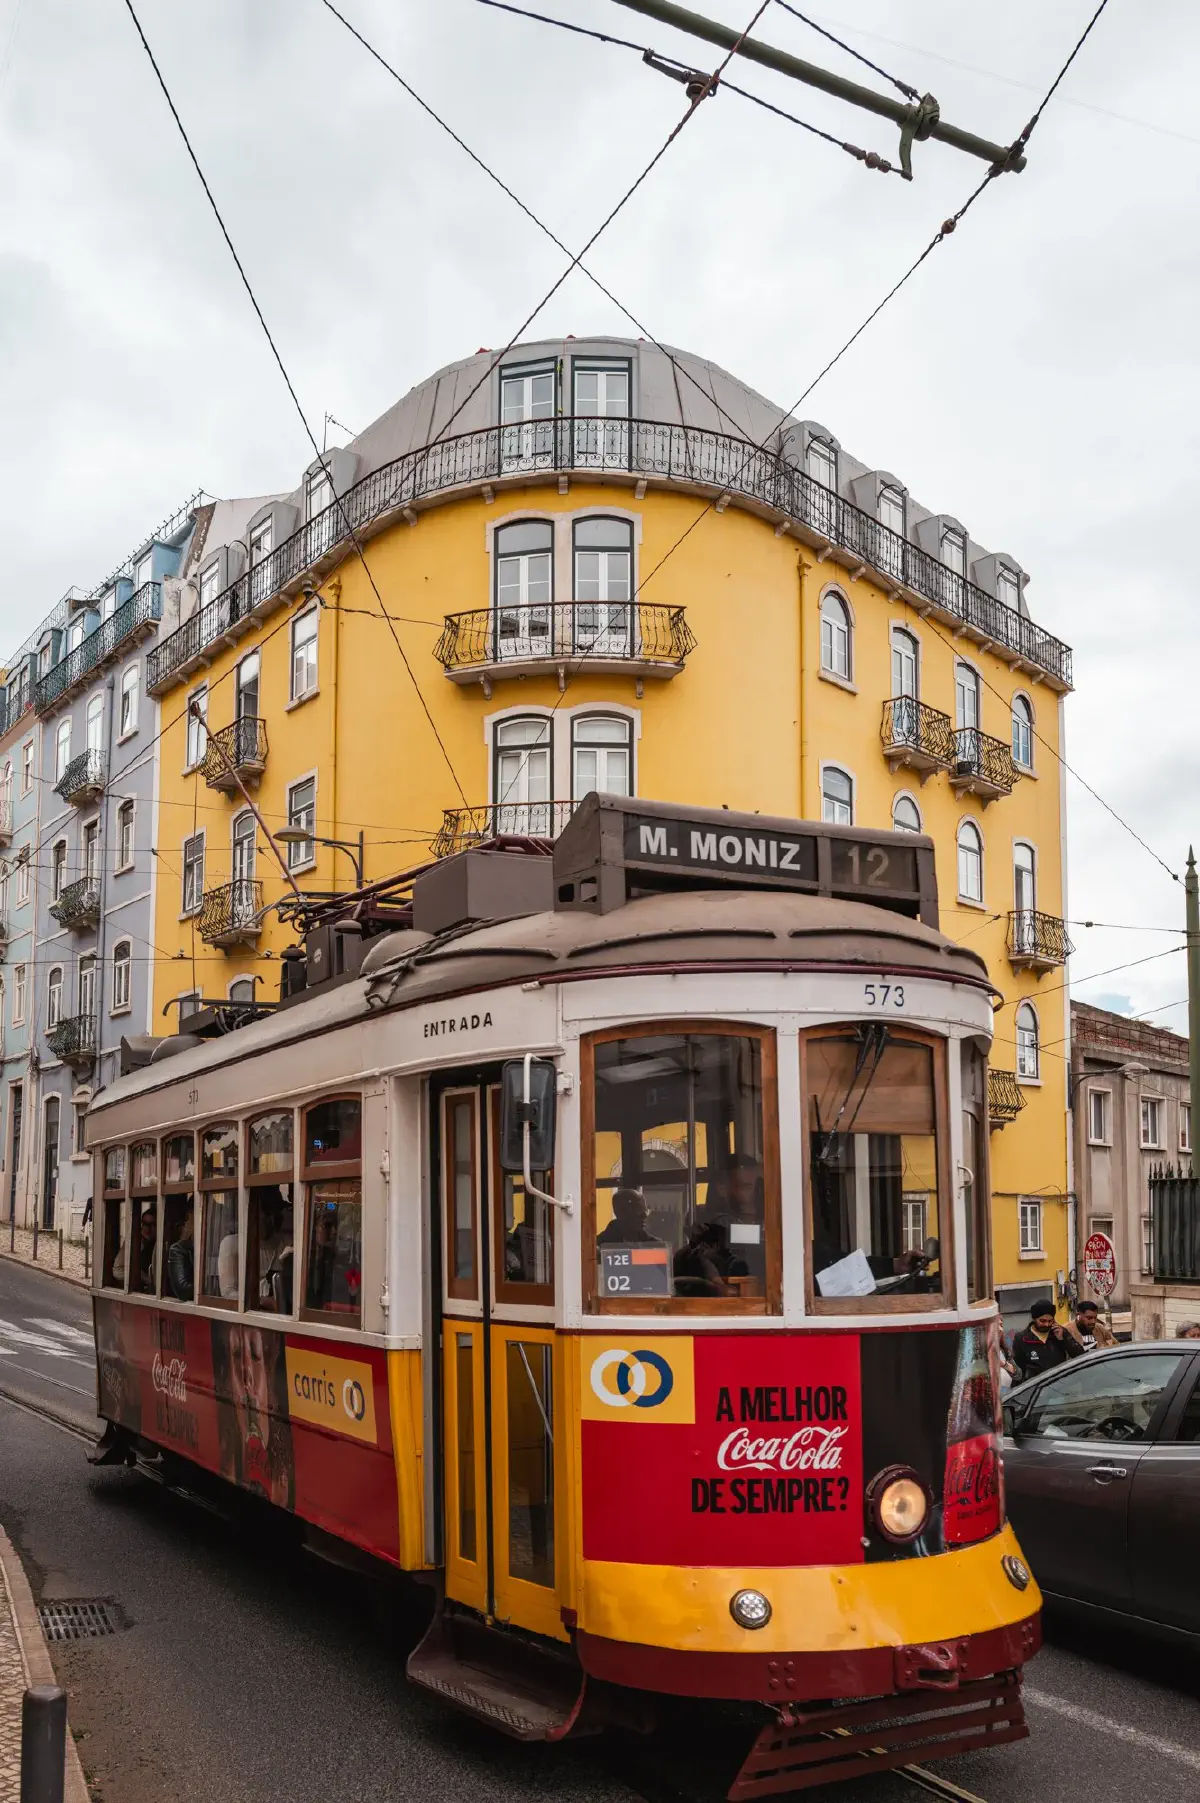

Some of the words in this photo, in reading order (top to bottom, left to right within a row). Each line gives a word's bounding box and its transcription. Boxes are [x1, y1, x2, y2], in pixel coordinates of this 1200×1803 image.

[639, 825, 679, 858] M.
[690, 830, 801, 871] MONIZ
[847, 845, 891, 887] 12
[863, 984, 905, 1008] 573
[423, 1012, 493, 1038] ENTRADA
[606, 1254, 629, 1266] 12E
[607, 1275, 631, 1291] 02
[294, 1369, 336, 1407] carris
[715, 1387, 737, 1422] A
[740, 1385, 848, 1422] MELHOR
[716, 1425, 849, 1471] Coca-Cola
[691, 1477, 725, 1513] DE
[730, 1477, 849, 1514] SEMPRE?
